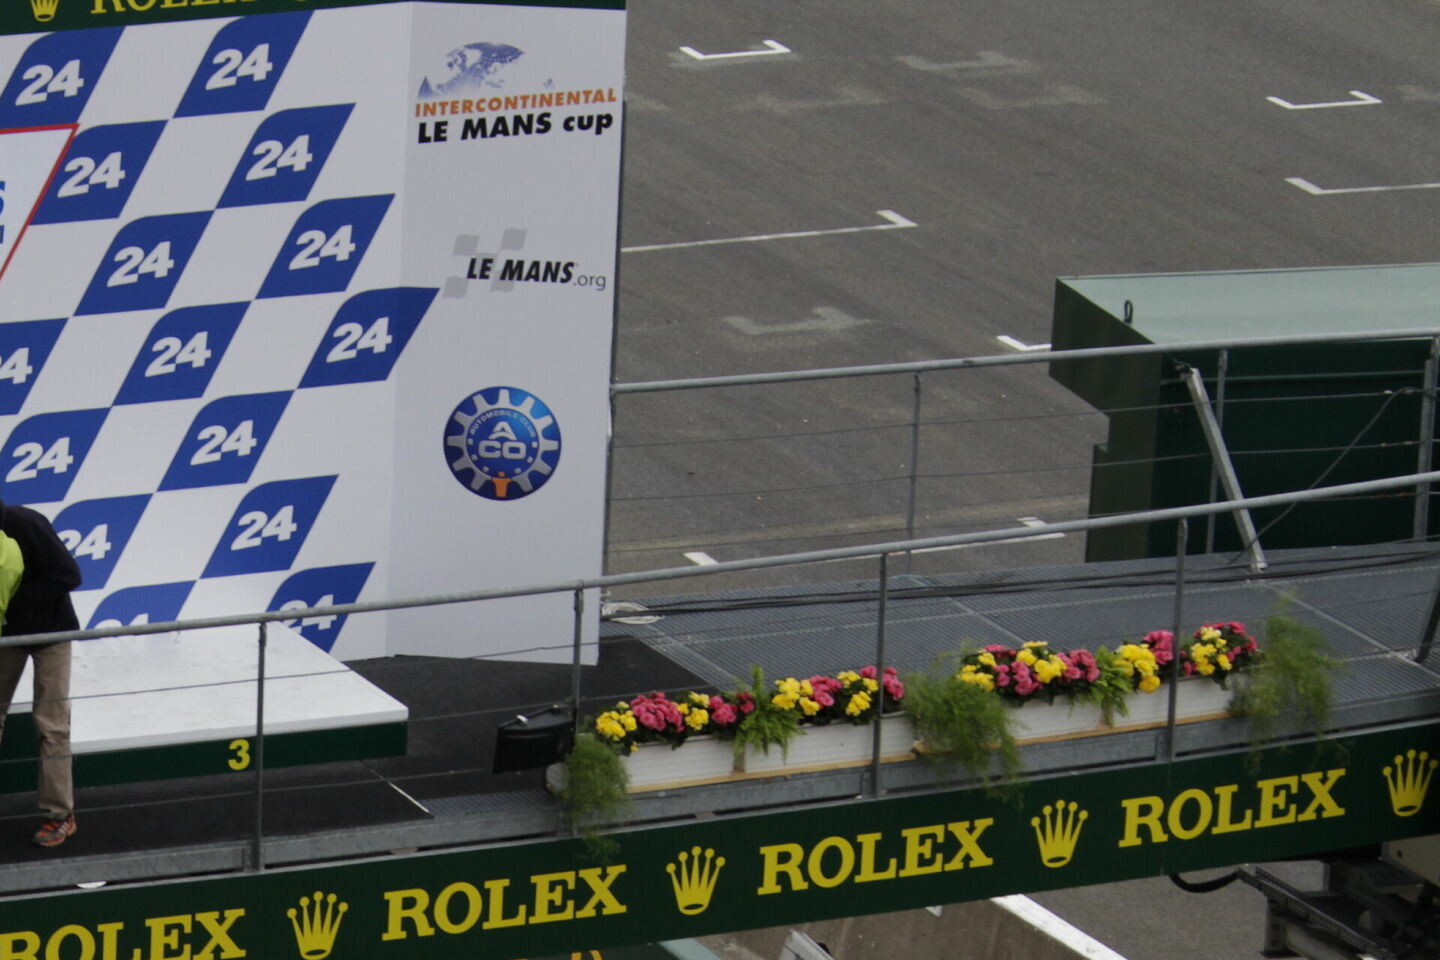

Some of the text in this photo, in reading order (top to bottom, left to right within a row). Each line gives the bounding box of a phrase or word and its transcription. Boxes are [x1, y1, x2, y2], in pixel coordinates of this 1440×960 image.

[15, 59, 84, 106] 24
[205, 45, 272, 91] 24
[415, 88, 617, 117] INTERCONTINENTAL
[418, 112, 614, 144] LE MANS cup
[57, 151, 125, 198] 24
[245, 134, 312, 180] 24
[107, 241, 174, 287] 24
[288, 224, 355, 271] 24
[467, 258, 493, 280] LE
[144, 331, 211, 377] 24
[326, 316, 392, 363] 24
[5, 437, 73, 483] 24
[190, 419, 257, 465] 24
[231, 505, 297, 551] 24
[227, 739, 251, 771] 3
[1118, 769, 1346, 849] ROLEX
[757, 817, 994, 896] ROLEX
[382, 864, 627, 941] ROLEX
